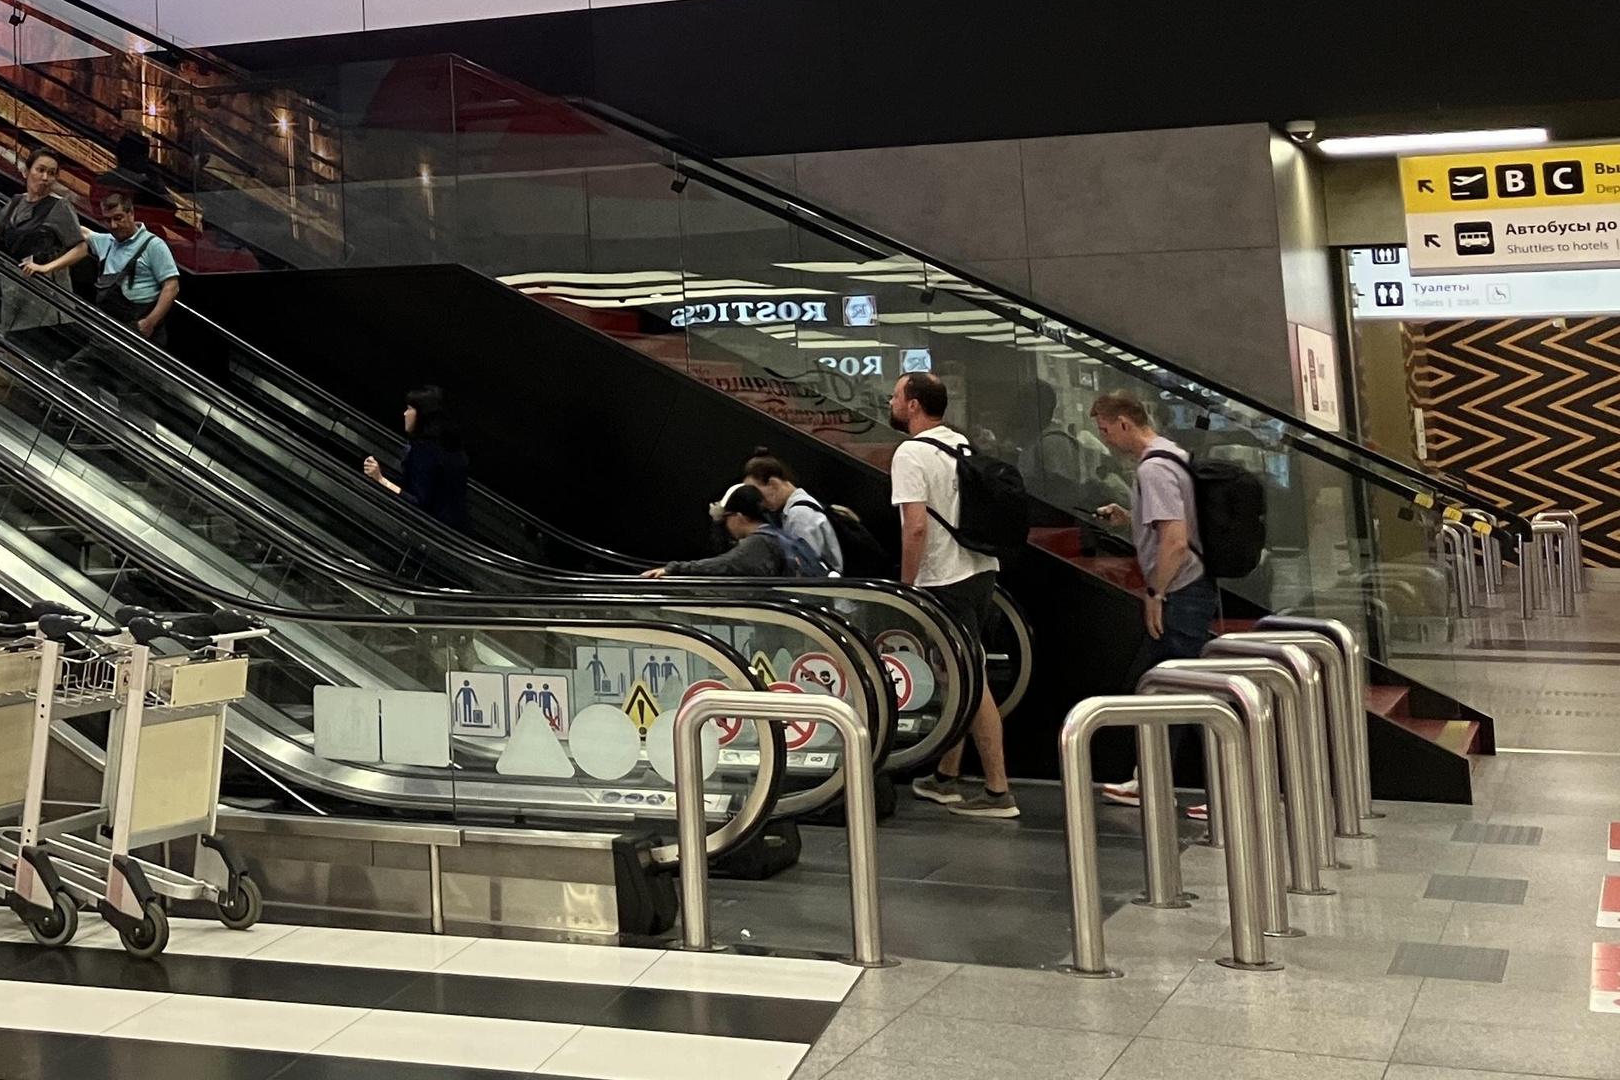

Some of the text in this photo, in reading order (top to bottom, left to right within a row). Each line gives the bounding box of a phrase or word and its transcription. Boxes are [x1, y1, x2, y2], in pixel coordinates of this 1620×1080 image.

[1505, 167, 1574, 192] B C
[1506, 220, 1617, 236] Автобусы до
[1507, 241, 1609, 255] Shuttles to hotels
[1412, 282, 1470, 294] Туалеты
